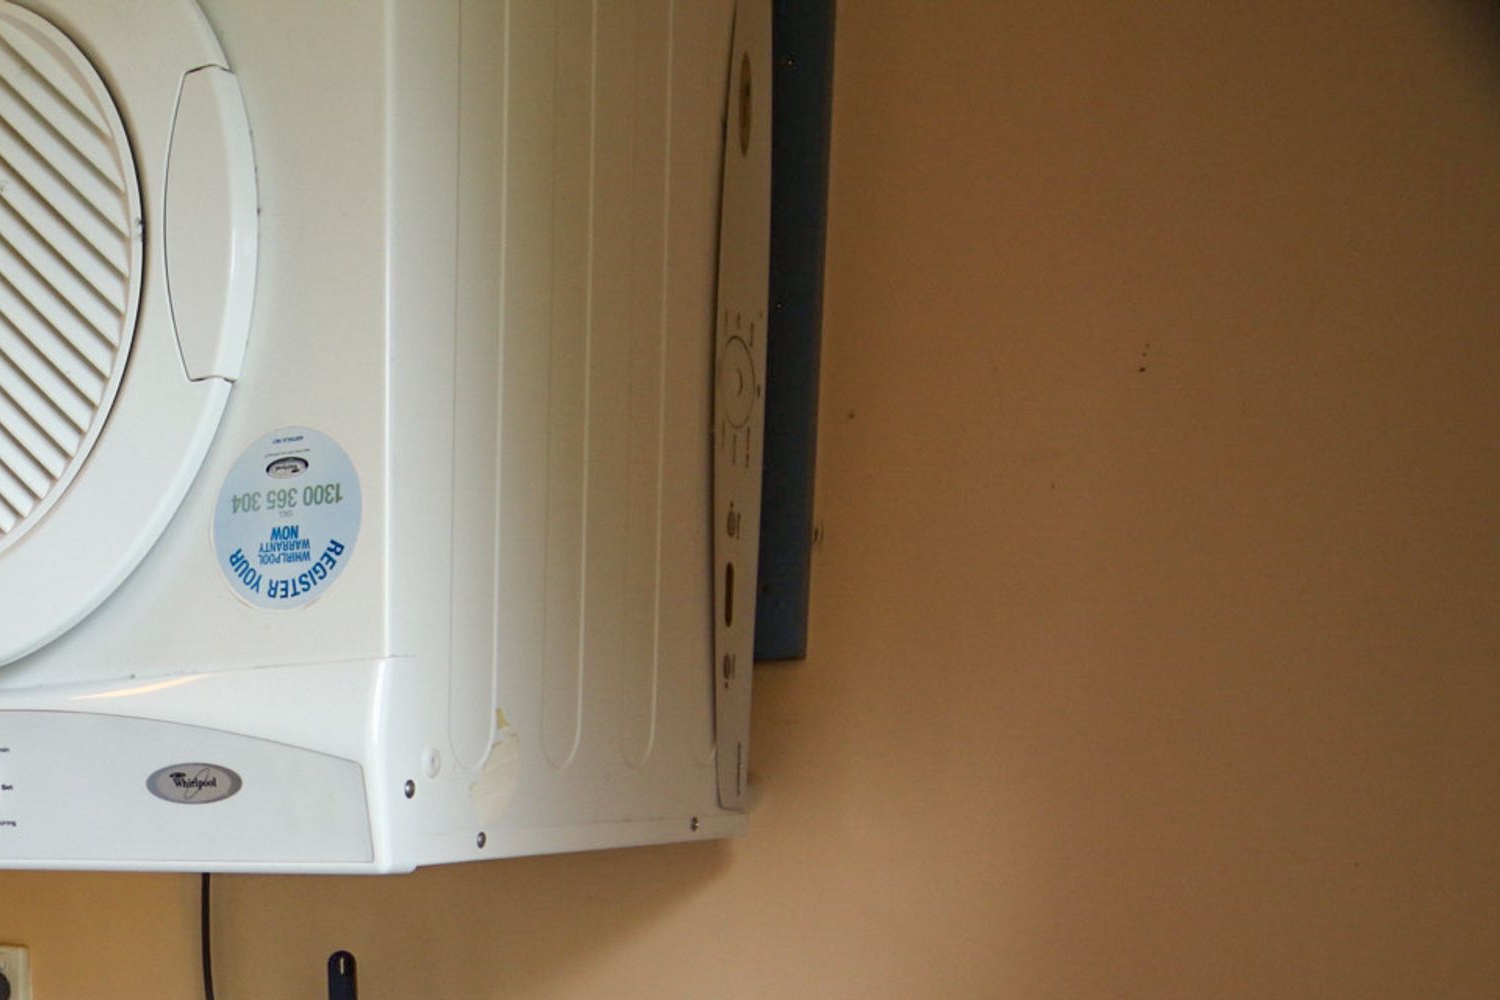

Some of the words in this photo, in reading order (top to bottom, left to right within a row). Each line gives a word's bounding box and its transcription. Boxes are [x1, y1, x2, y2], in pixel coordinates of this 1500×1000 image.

[231, 491, 261, 513] 304
[266, 487, 298, 510] 365
[303, 483, 343, 506] 1300
[271, 525, 299, 541] NOW
[259, 539, 311, 553] WARRANTY
[258, 551, 311, 565] WHIRLPOOL
[268, 539, 345, 599] REGISTER
[229, 548, 262, 593] YOUR
[169, 771, 217, 791] Whirlpool
